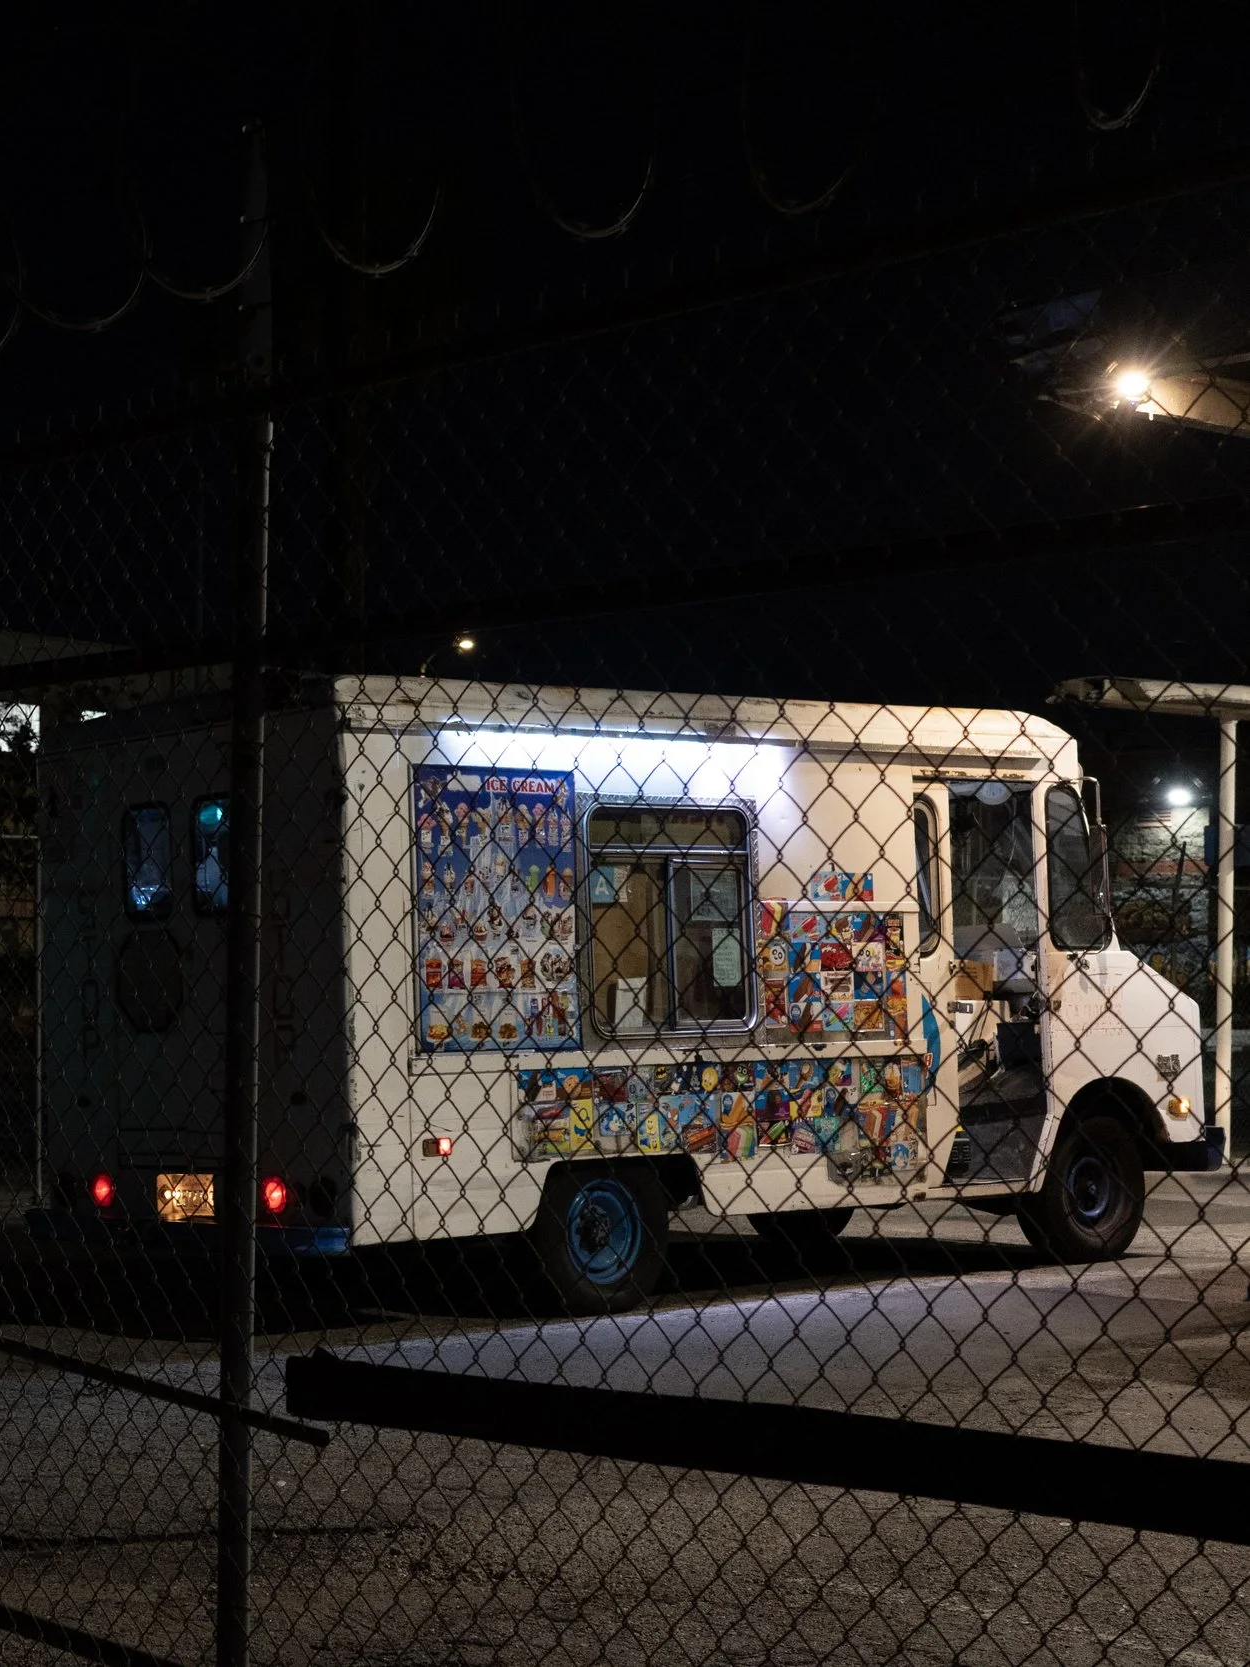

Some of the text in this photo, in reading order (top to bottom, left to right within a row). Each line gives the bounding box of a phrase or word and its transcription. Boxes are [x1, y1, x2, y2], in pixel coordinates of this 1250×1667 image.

[486, 778, 556, 794] ICE CREAM
[595, 877, 609, 896] A
